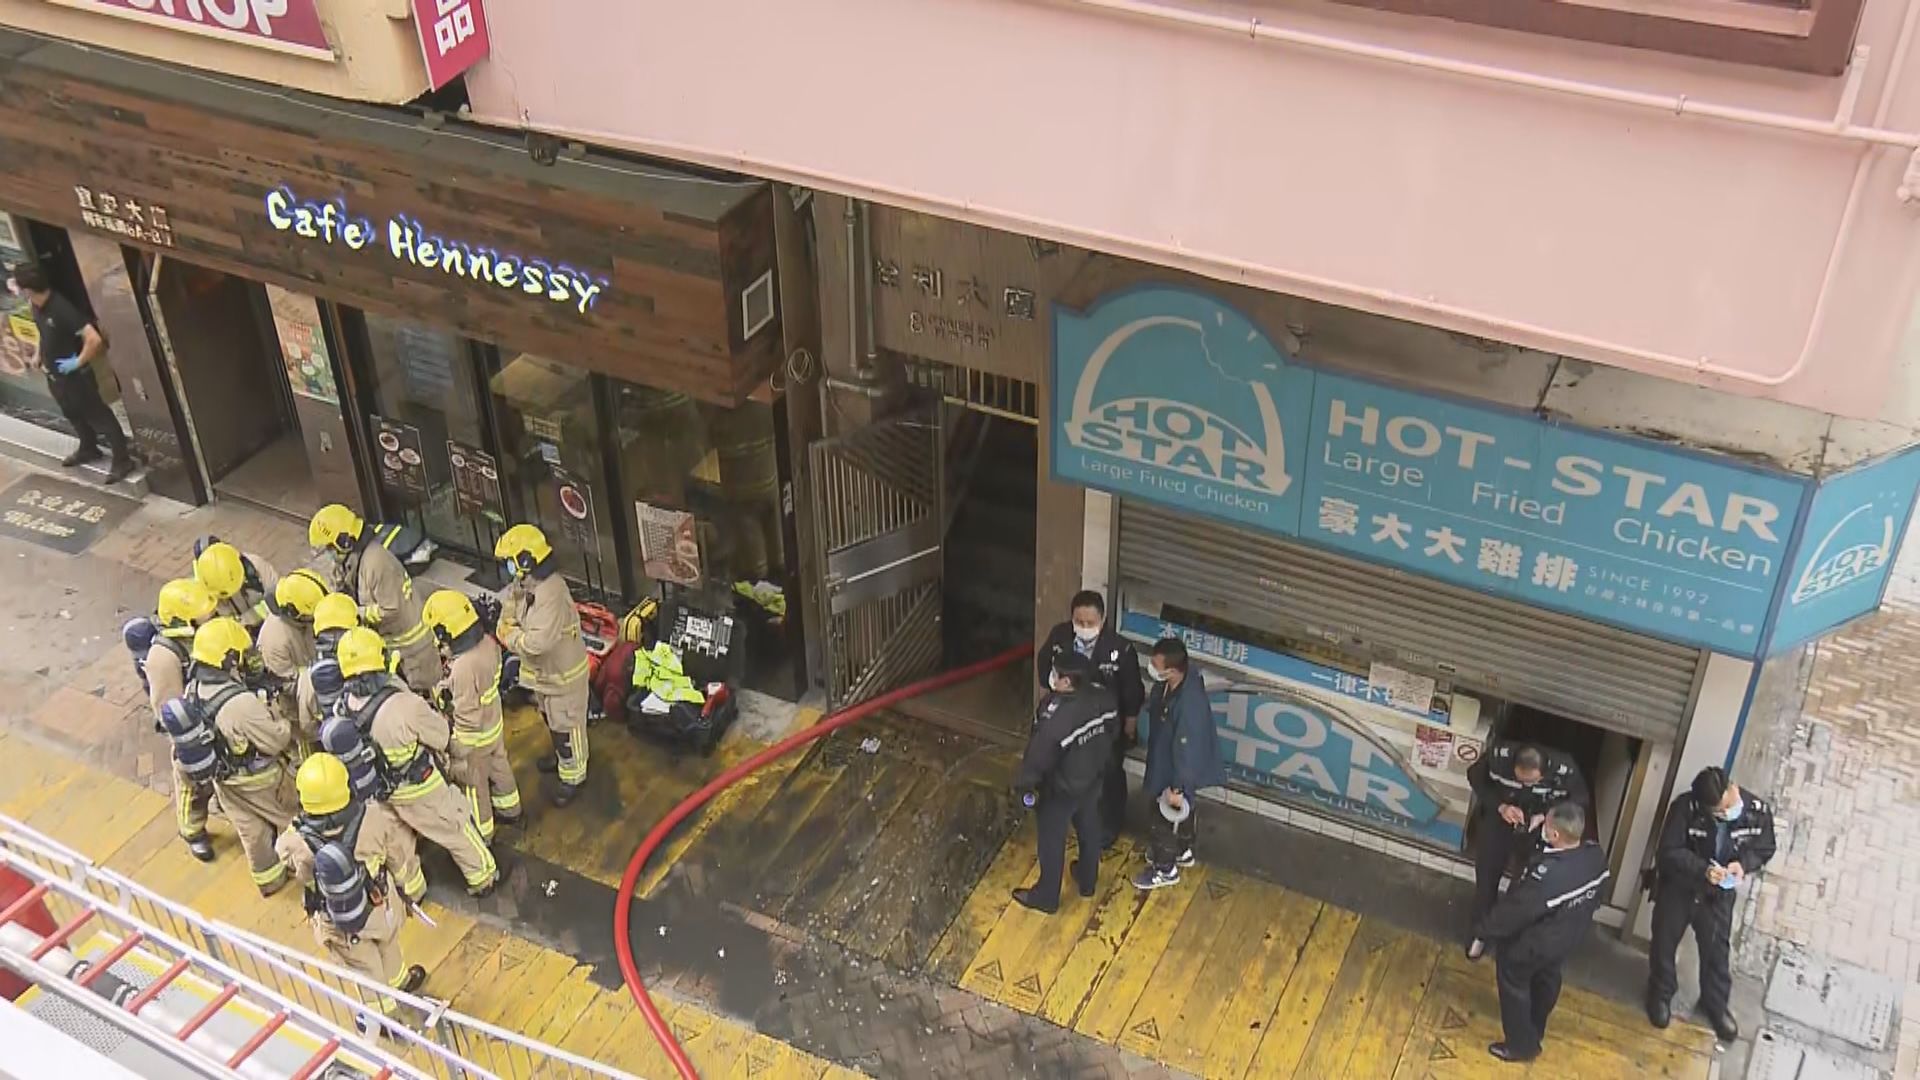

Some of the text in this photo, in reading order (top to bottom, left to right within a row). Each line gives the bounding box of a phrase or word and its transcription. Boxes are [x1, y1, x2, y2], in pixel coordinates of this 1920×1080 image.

[128, 0, 288, 35] HOP
[266, 189, 366, 250] Cafe
[388, 218, 600, 314] Hennessy
[1080, 421, 1274, 490] STAR
[1102, 400, 1255, 451] HOT
[1080, 454, 1270, 513] Large Fried Chicken
[1323, 440, 1772, 577] Large Fried Chicken
[1318, 496, 1580, 593] 豪大大雞排
[1589, 565, 1709, 606] SINCE 1992
[1311, 670, 1392, 702] 一律不
[1214, 726, 1416, 819] TAR
